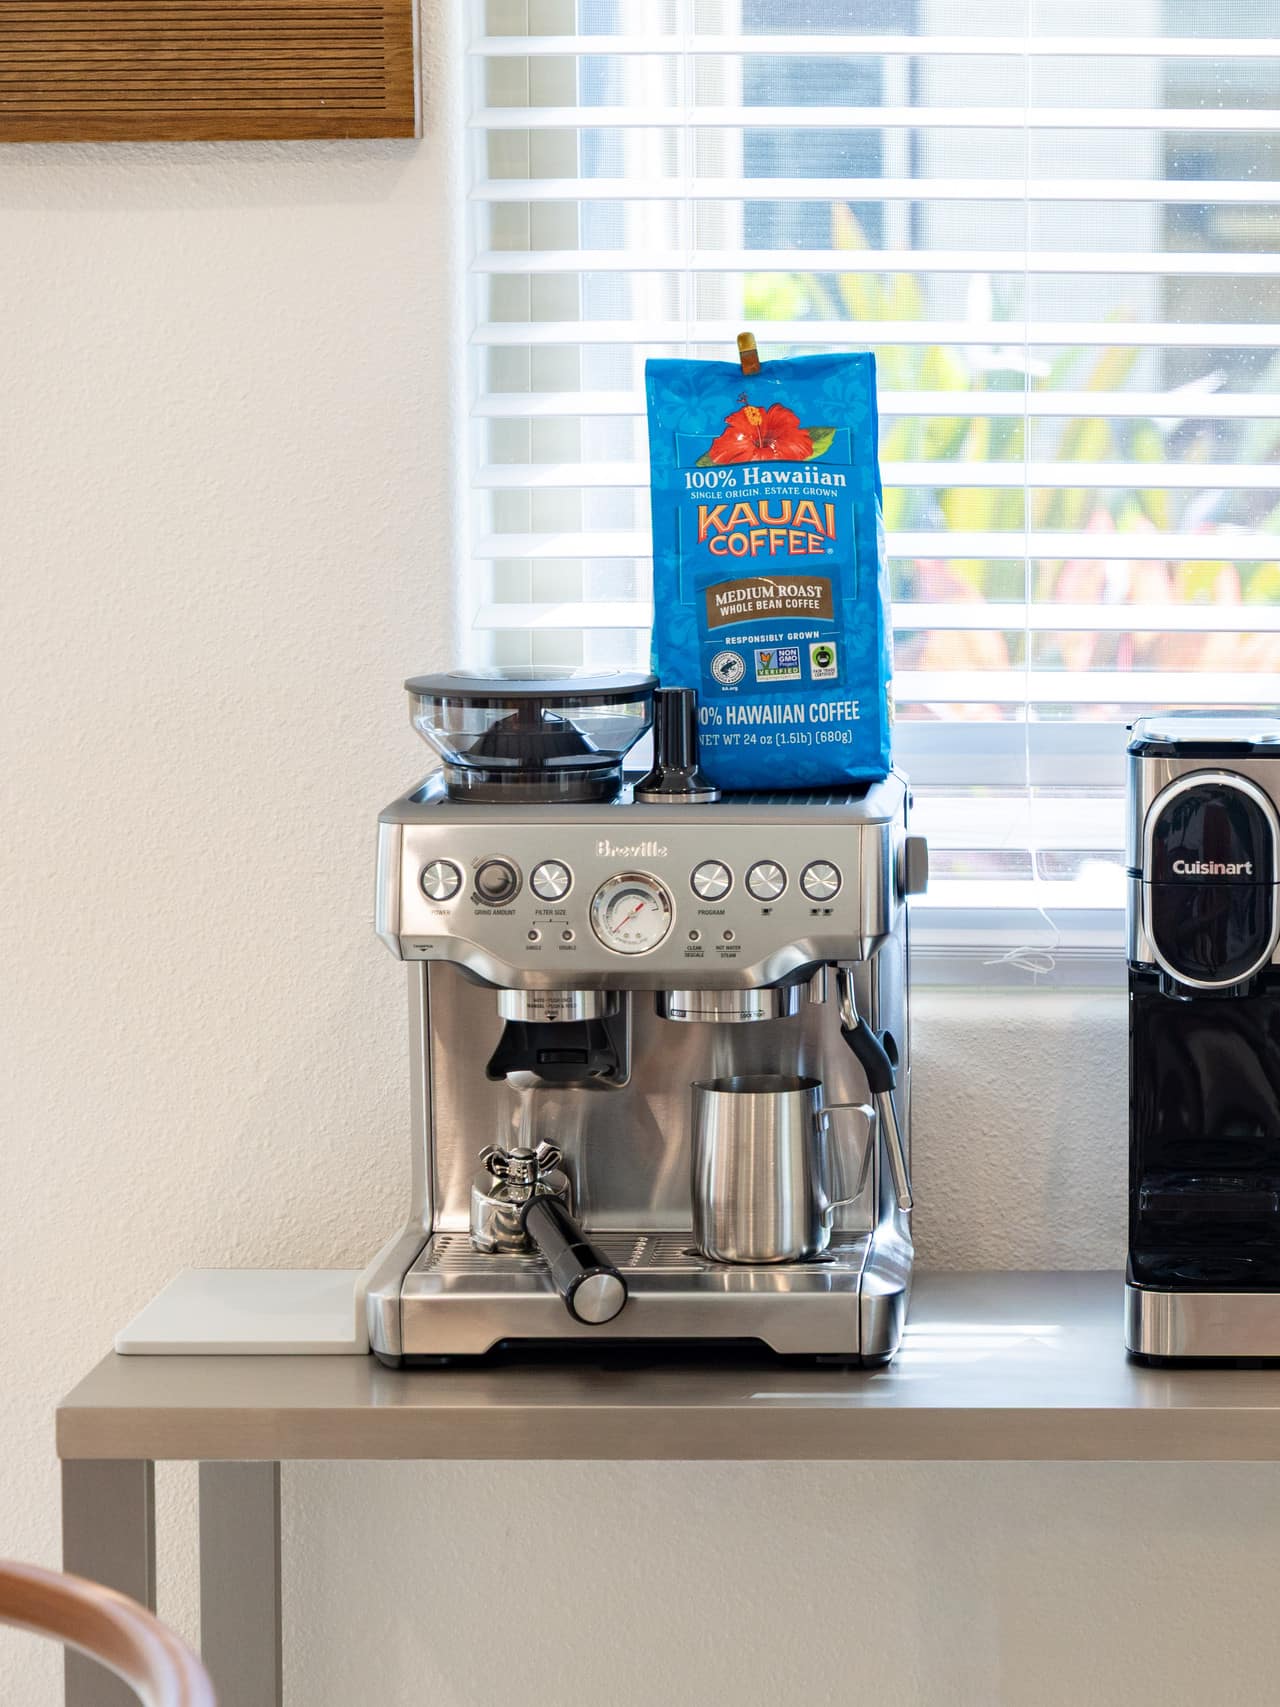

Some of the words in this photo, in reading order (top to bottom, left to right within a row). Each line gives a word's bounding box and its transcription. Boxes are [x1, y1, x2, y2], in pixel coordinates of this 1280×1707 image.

[684, 469, 737, 489] 100%
[742, 466, 847, 487] Hawaiian
[690, 491, 723, 500] SINGLE
[764, 486, 800, 495] ESTATE
[802, 487, 838, 497] GROWN
[697, 499, 837, 545] KAUAI
[708, 527, 826, 557] COFFEE
[715, 586, 774, 606] MEDIUM
[777, 585, 823, 598] ROAST
[719, 602, 753, 616] WHOLE
[756, 599, 783, 611] BEAN
[785, 599, 820, 609] COFFEE
[725, 633, 784, 645] RESPONSIBLY
[787, 631, 820, 640] GROWN
[778, 655, 798, 663] GMO
[757, 668, 799, 676] VERIFIED
[726, 703, 805, 725] HAWAIIAN
[808, 700, 861, 723] COFFEE
[722, 733, 741, 746] WT
[743, 733, 757, 745] 24
[759, 735, 773, 745] oz
[596, 839, 669, 857] Breville
[1172, 860, 1253, 875] Cuisinart
